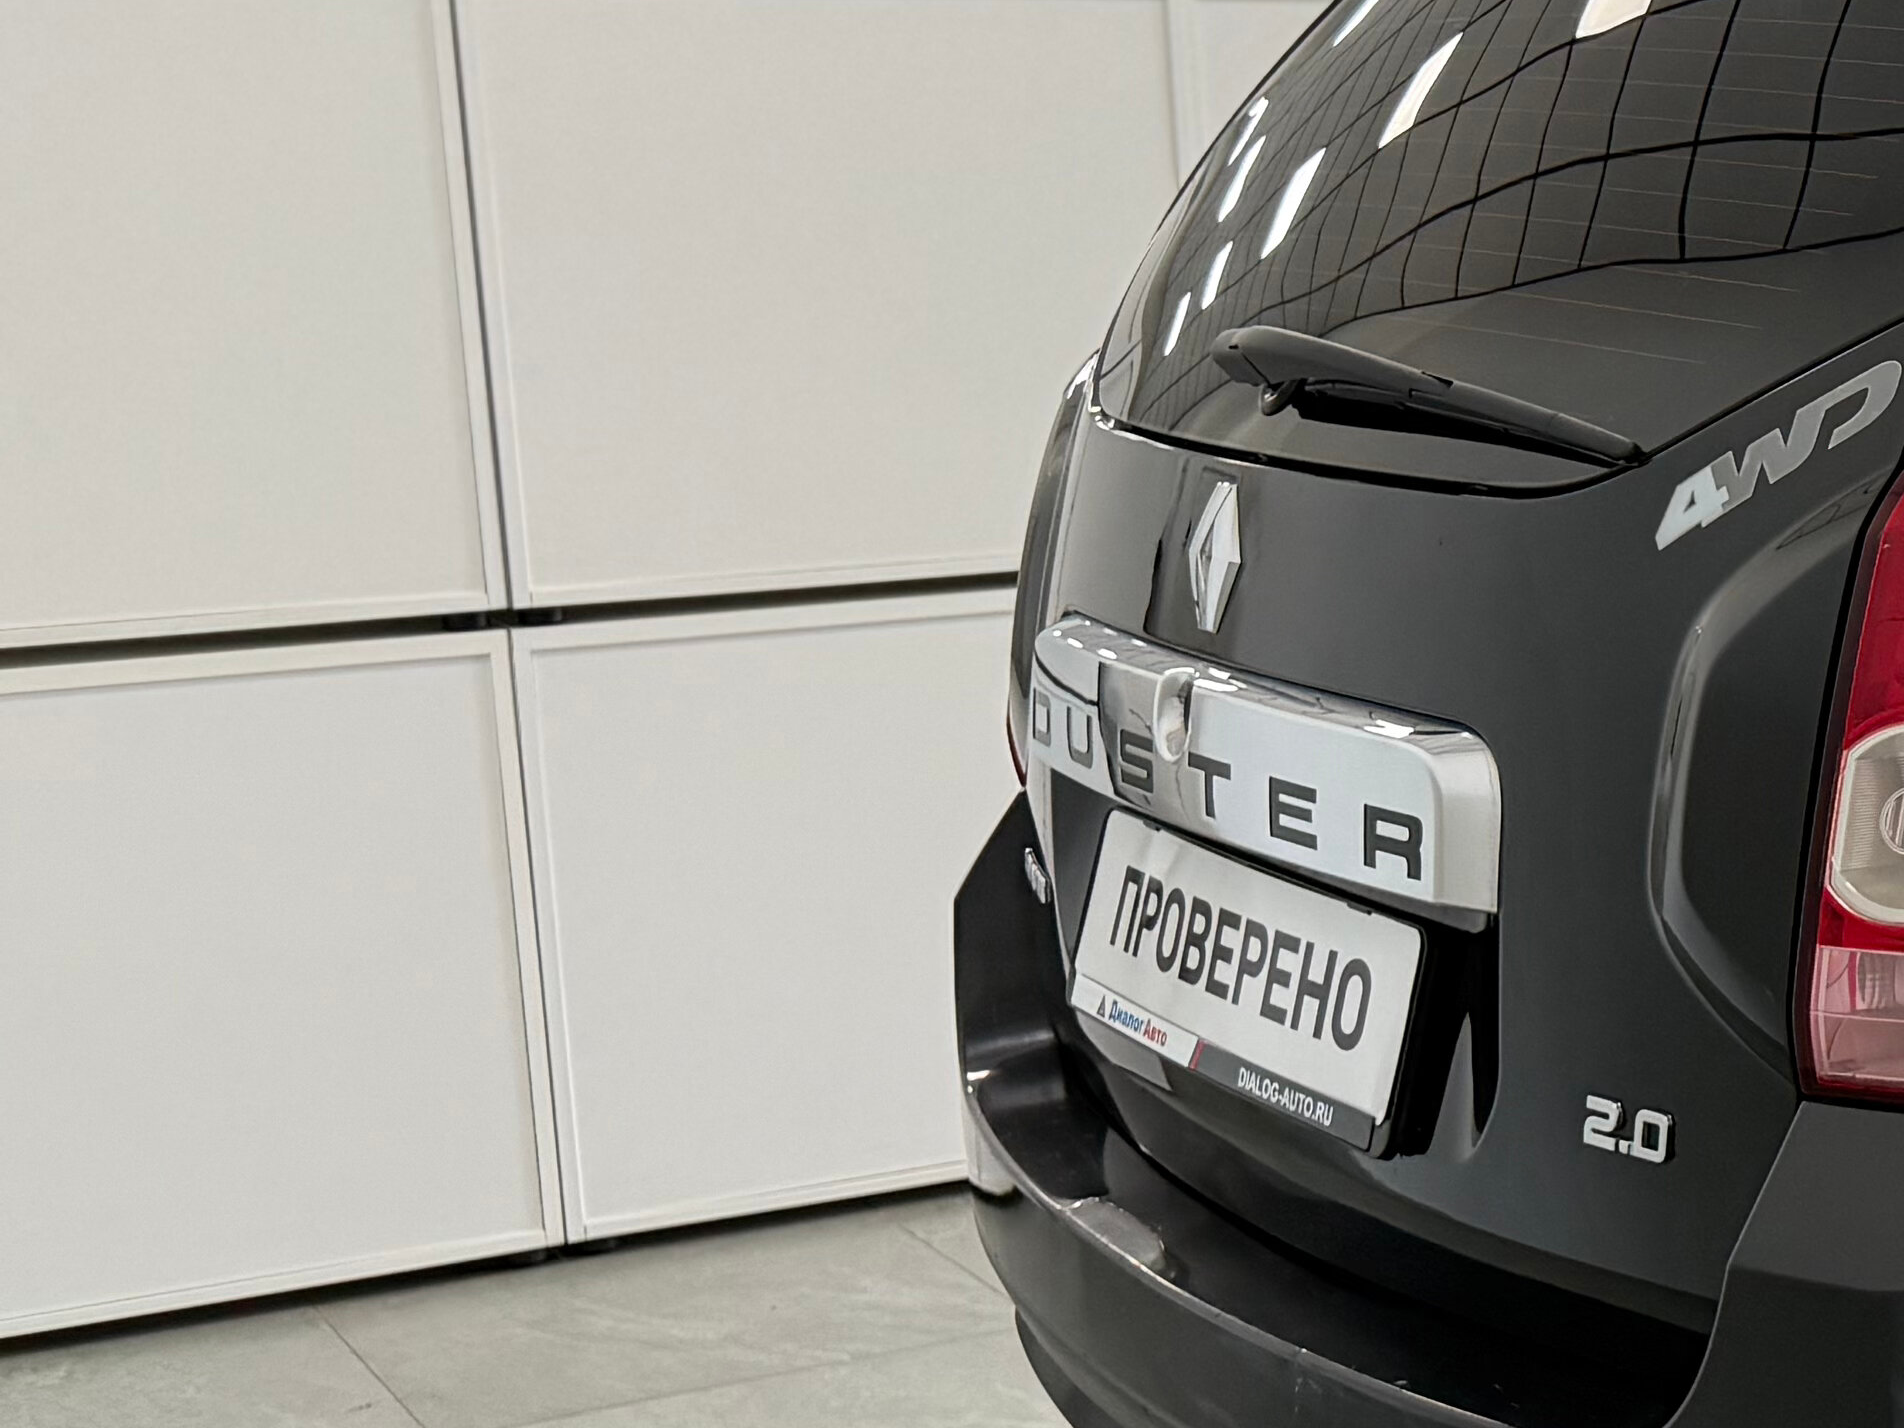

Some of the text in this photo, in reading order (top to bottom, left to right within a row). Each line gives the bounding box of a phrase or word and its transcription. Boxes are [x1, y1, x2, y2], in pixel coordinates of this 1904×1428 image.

[1655, 360, 1902, 551] 4WD
[1032, 687, 1423, 882] DUSTER
[1109, 865, 1372, 1051] ПРОВЕРЕНО
[1237, 1066, 1334, 1127] DIALOG-AUTO.RU
[1583, 1094, 1672, 1163] 2.0
